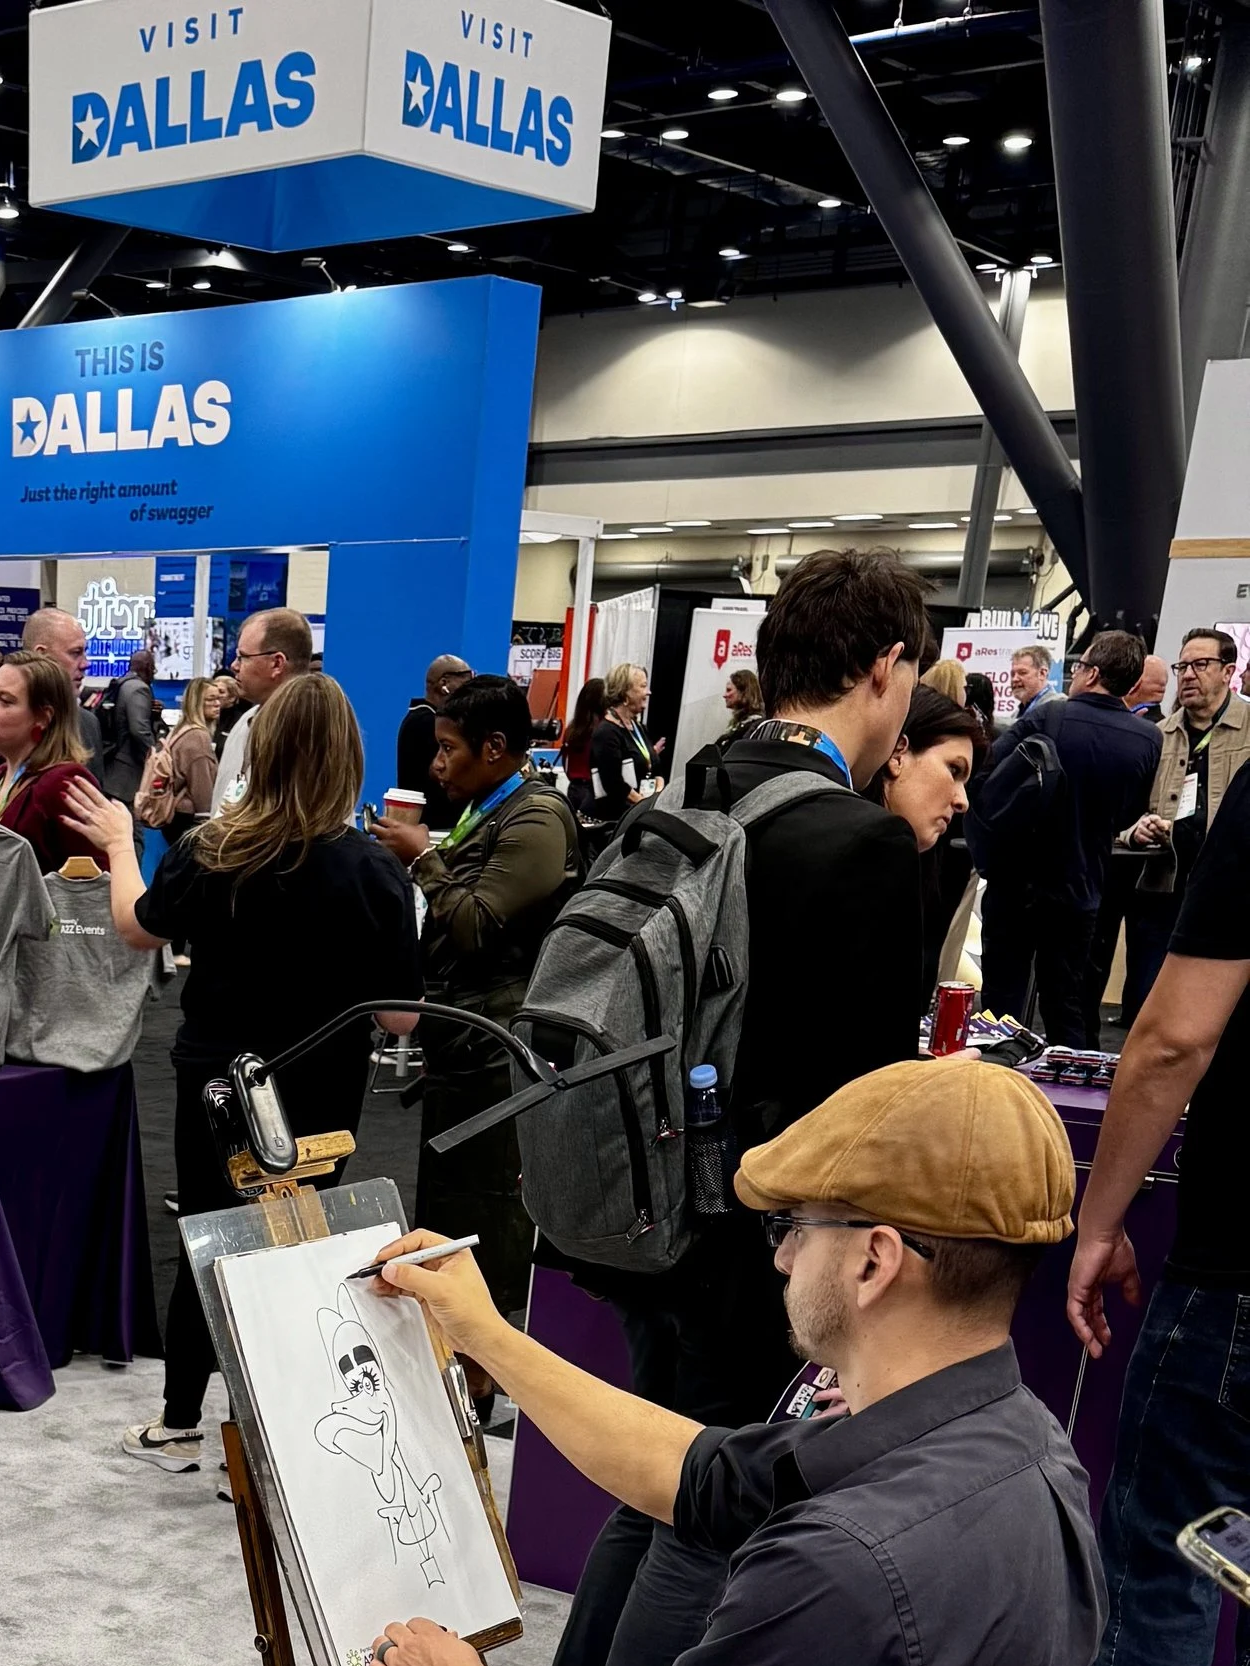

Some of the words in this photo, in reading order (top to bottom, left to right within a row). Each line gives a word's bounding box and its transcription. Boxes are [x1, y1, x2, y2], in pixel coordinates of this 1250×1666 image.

[140, 7, 243, 53] VISIT
[461, 10, 533, 58] VISIT
[72, 51, 316, 164] DALLAS
[402, 49, 573, 167] DALLAS
[76, 344, 135, 377] THIS
[140, 341, 165, 372] IS
[12, 380, 232, 458] DALLAS
[20, 485, 52, 503] Just
[53, 483, 77, 501] the
[79, 480, 116, 505] right
[117, 479, 178, 499] amount
[129, 503, 148, 522] of
[148, 504, 215, 525] swagger
[60, 925, 75, 934] A2Z
[75, 926, 105, 936] Events
